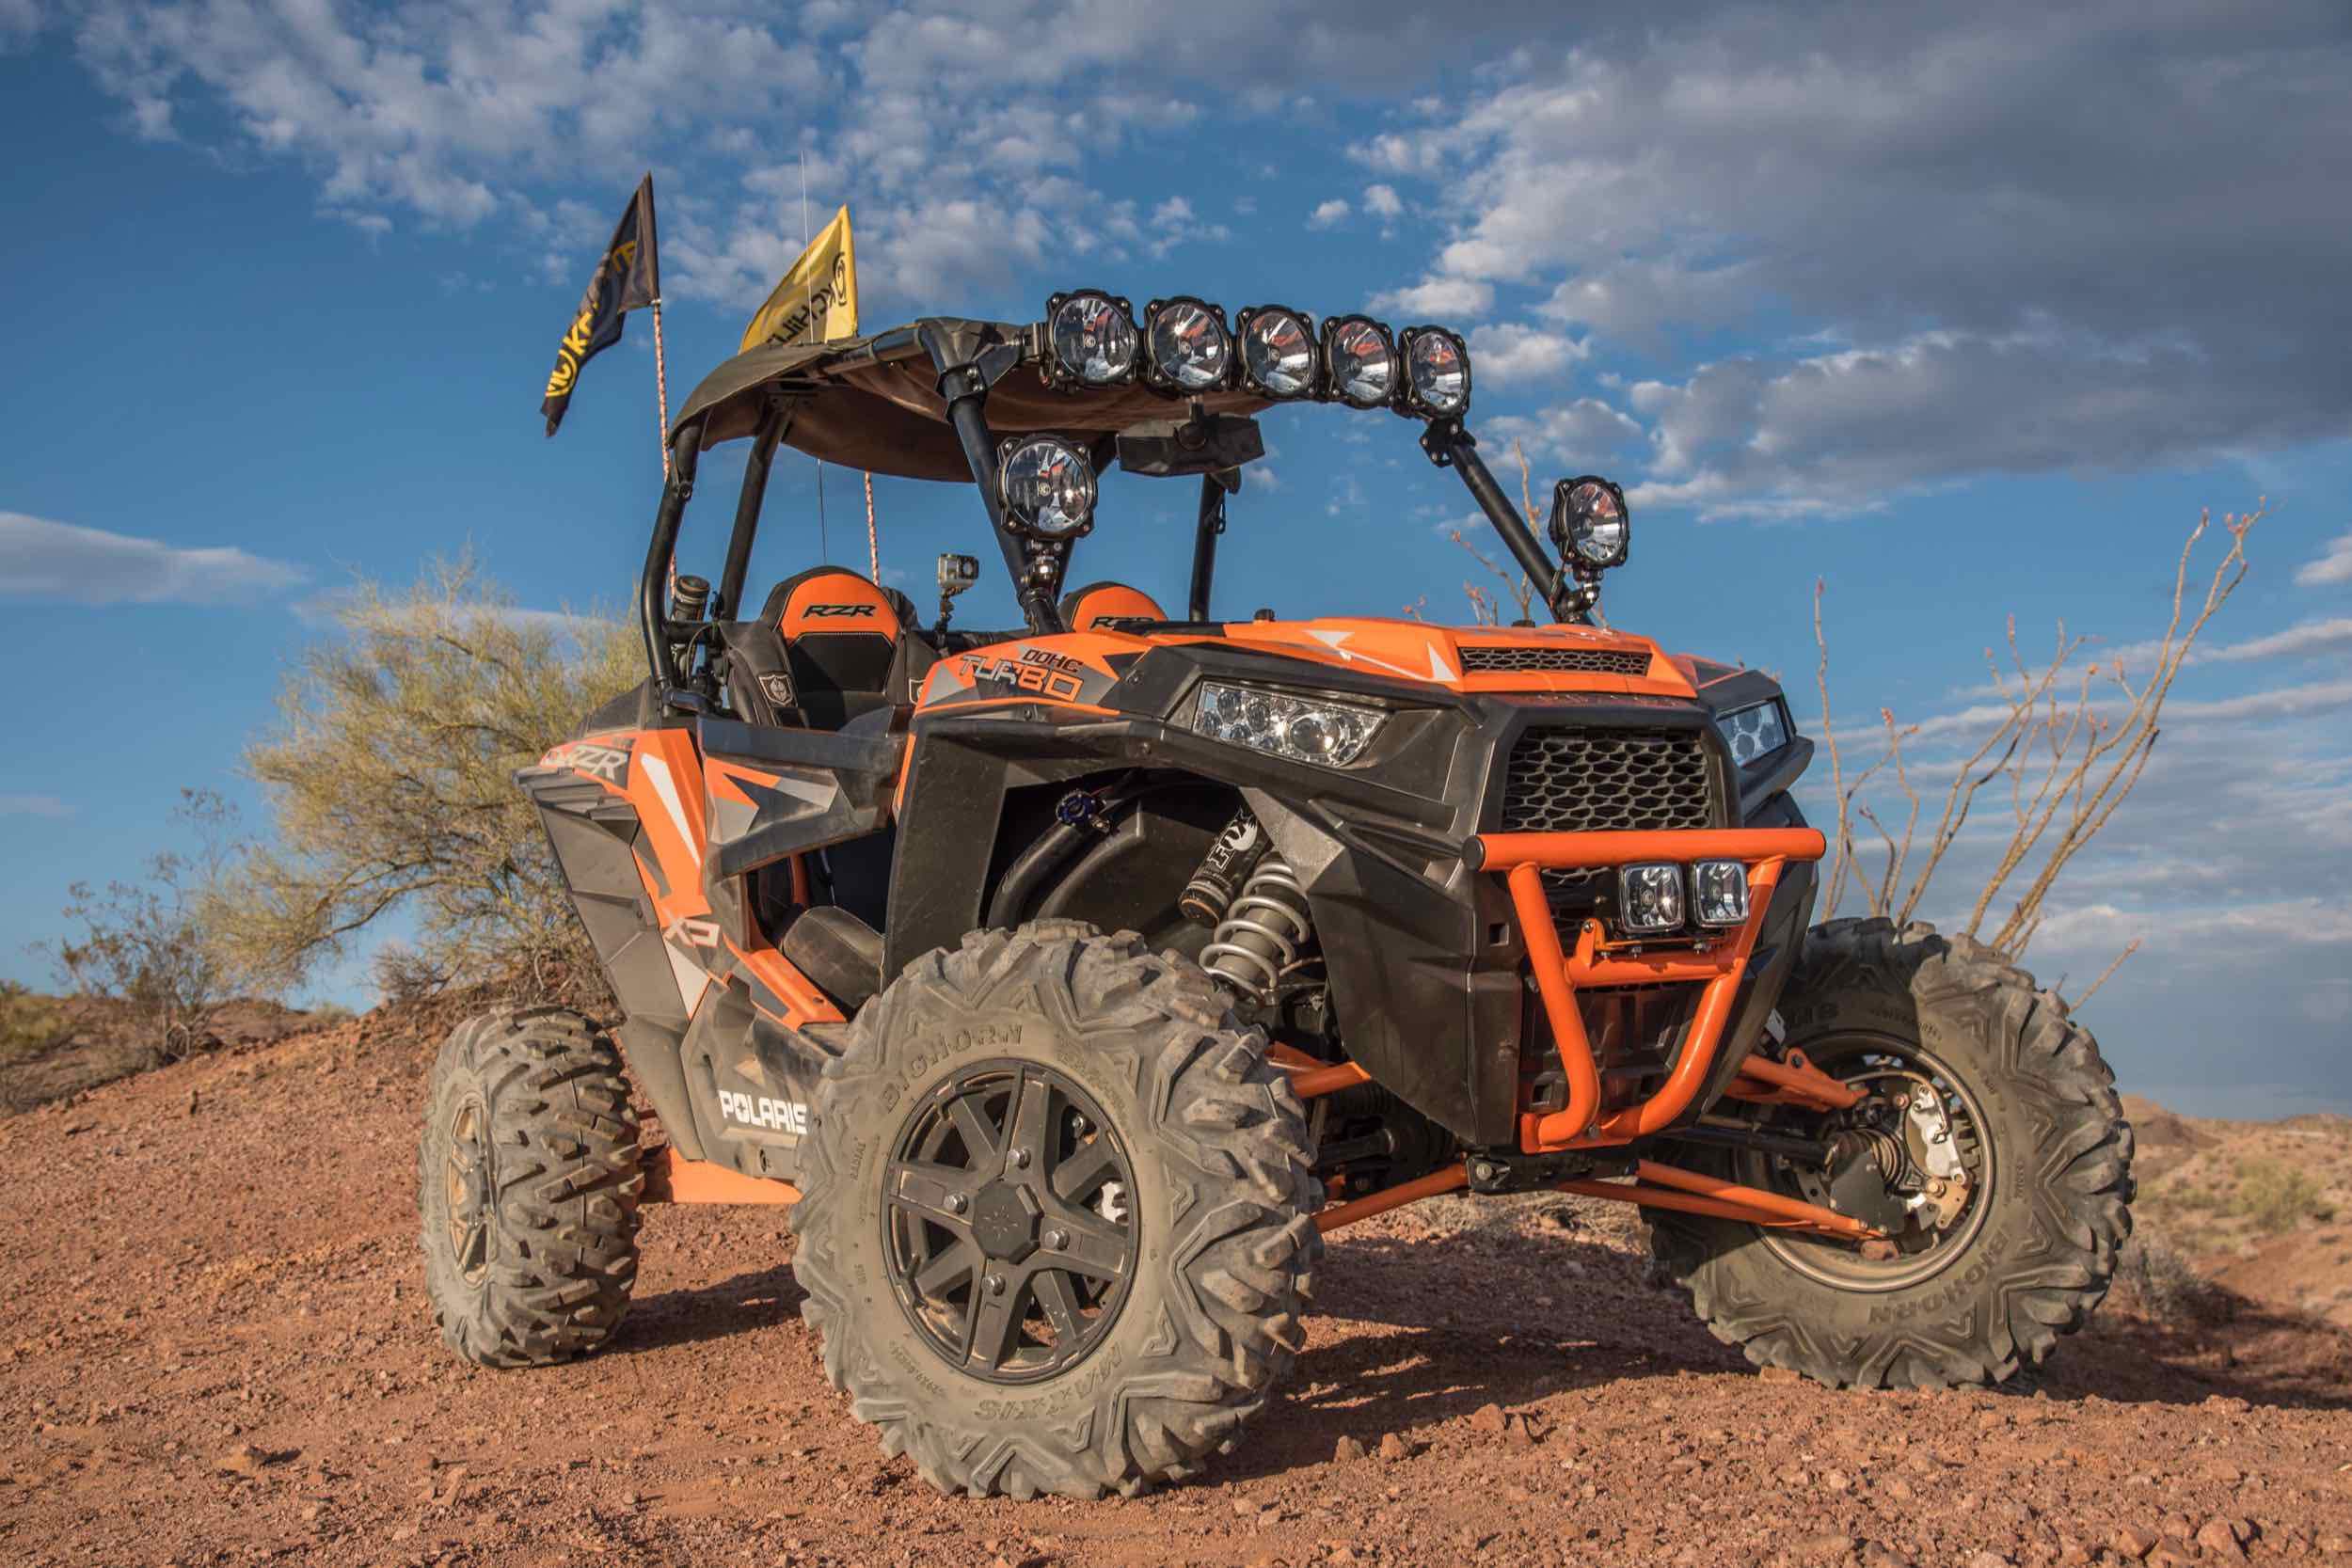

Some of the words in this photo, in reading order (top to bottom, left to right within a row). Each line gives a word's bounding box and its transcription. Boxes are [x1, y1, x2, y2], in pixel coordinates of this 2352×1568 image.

[802, 605, 876, 619] RZR
[960, 655, 1084, 703] TURBO
[1023, 648, 1084, 673] DOHC
[1206, 807, 1255, 870] FOX
[661, 907, 721, 948] XP
[880, 1023, 1024, 1114] BIGHORN
[718, 1089, 807, 1135] POLARIS
